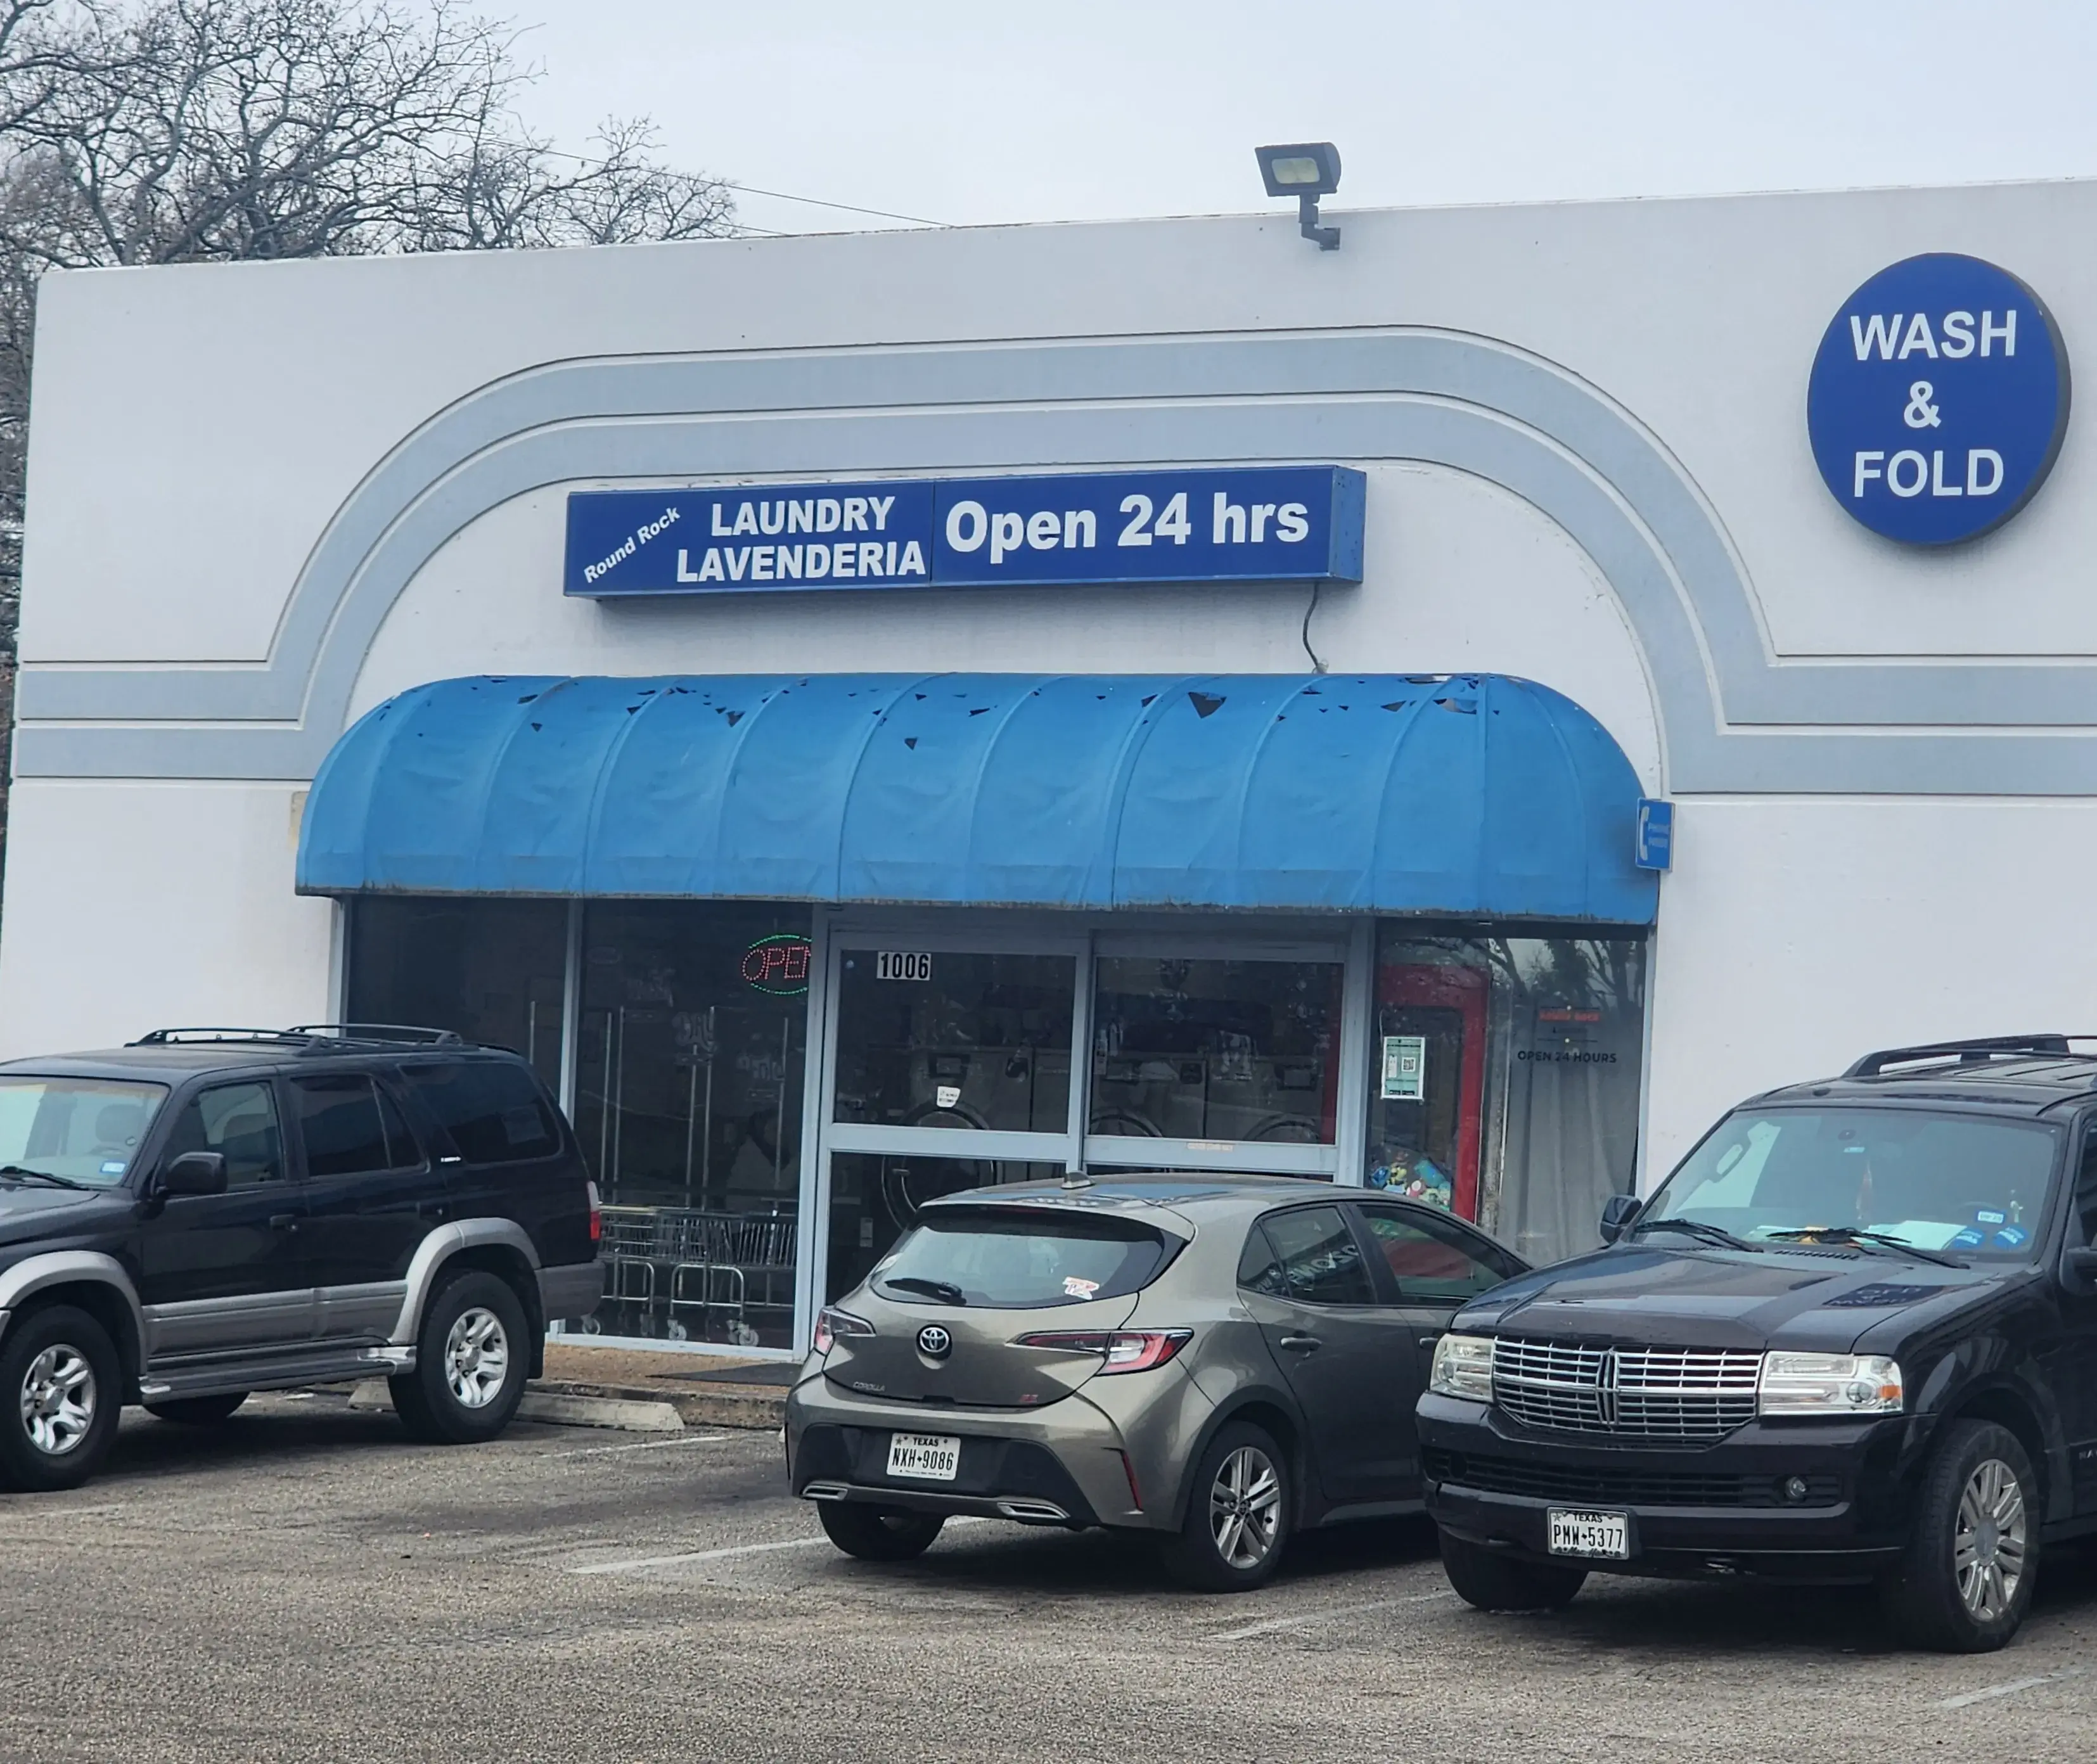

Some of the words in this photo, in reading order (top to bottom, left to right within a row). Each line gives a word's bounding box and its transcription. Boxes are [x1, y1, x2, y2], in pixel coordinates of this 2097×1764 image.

[1850, 310, 2017, 361] WASH
[1904, 380, 1942, 429] &
[1854, 449, 2004, 497] FOLD
[711, 495, 895, 537] LAUNDRY
[946, 500, 1096, 564] Open
[1117, 492, 1191, 546] 24
[1213, 492, 1309, 544] hrs
[584, 536, 636, 583] Round
[637, 507, 681, 545] Rock
[676, 540, 926, 582] LAVENDERIA
[881, 953, 929, 979] 1006
[1517, 1051, 1551, 1061] OPEN
[1555, 1052, 1569, 1061] 24
[1574, 1052, 1617, 1063] HOURS
[913, 1437, 939, 1447] TEXAS
[1574, 1513, 1603, 1523] TEXAS
